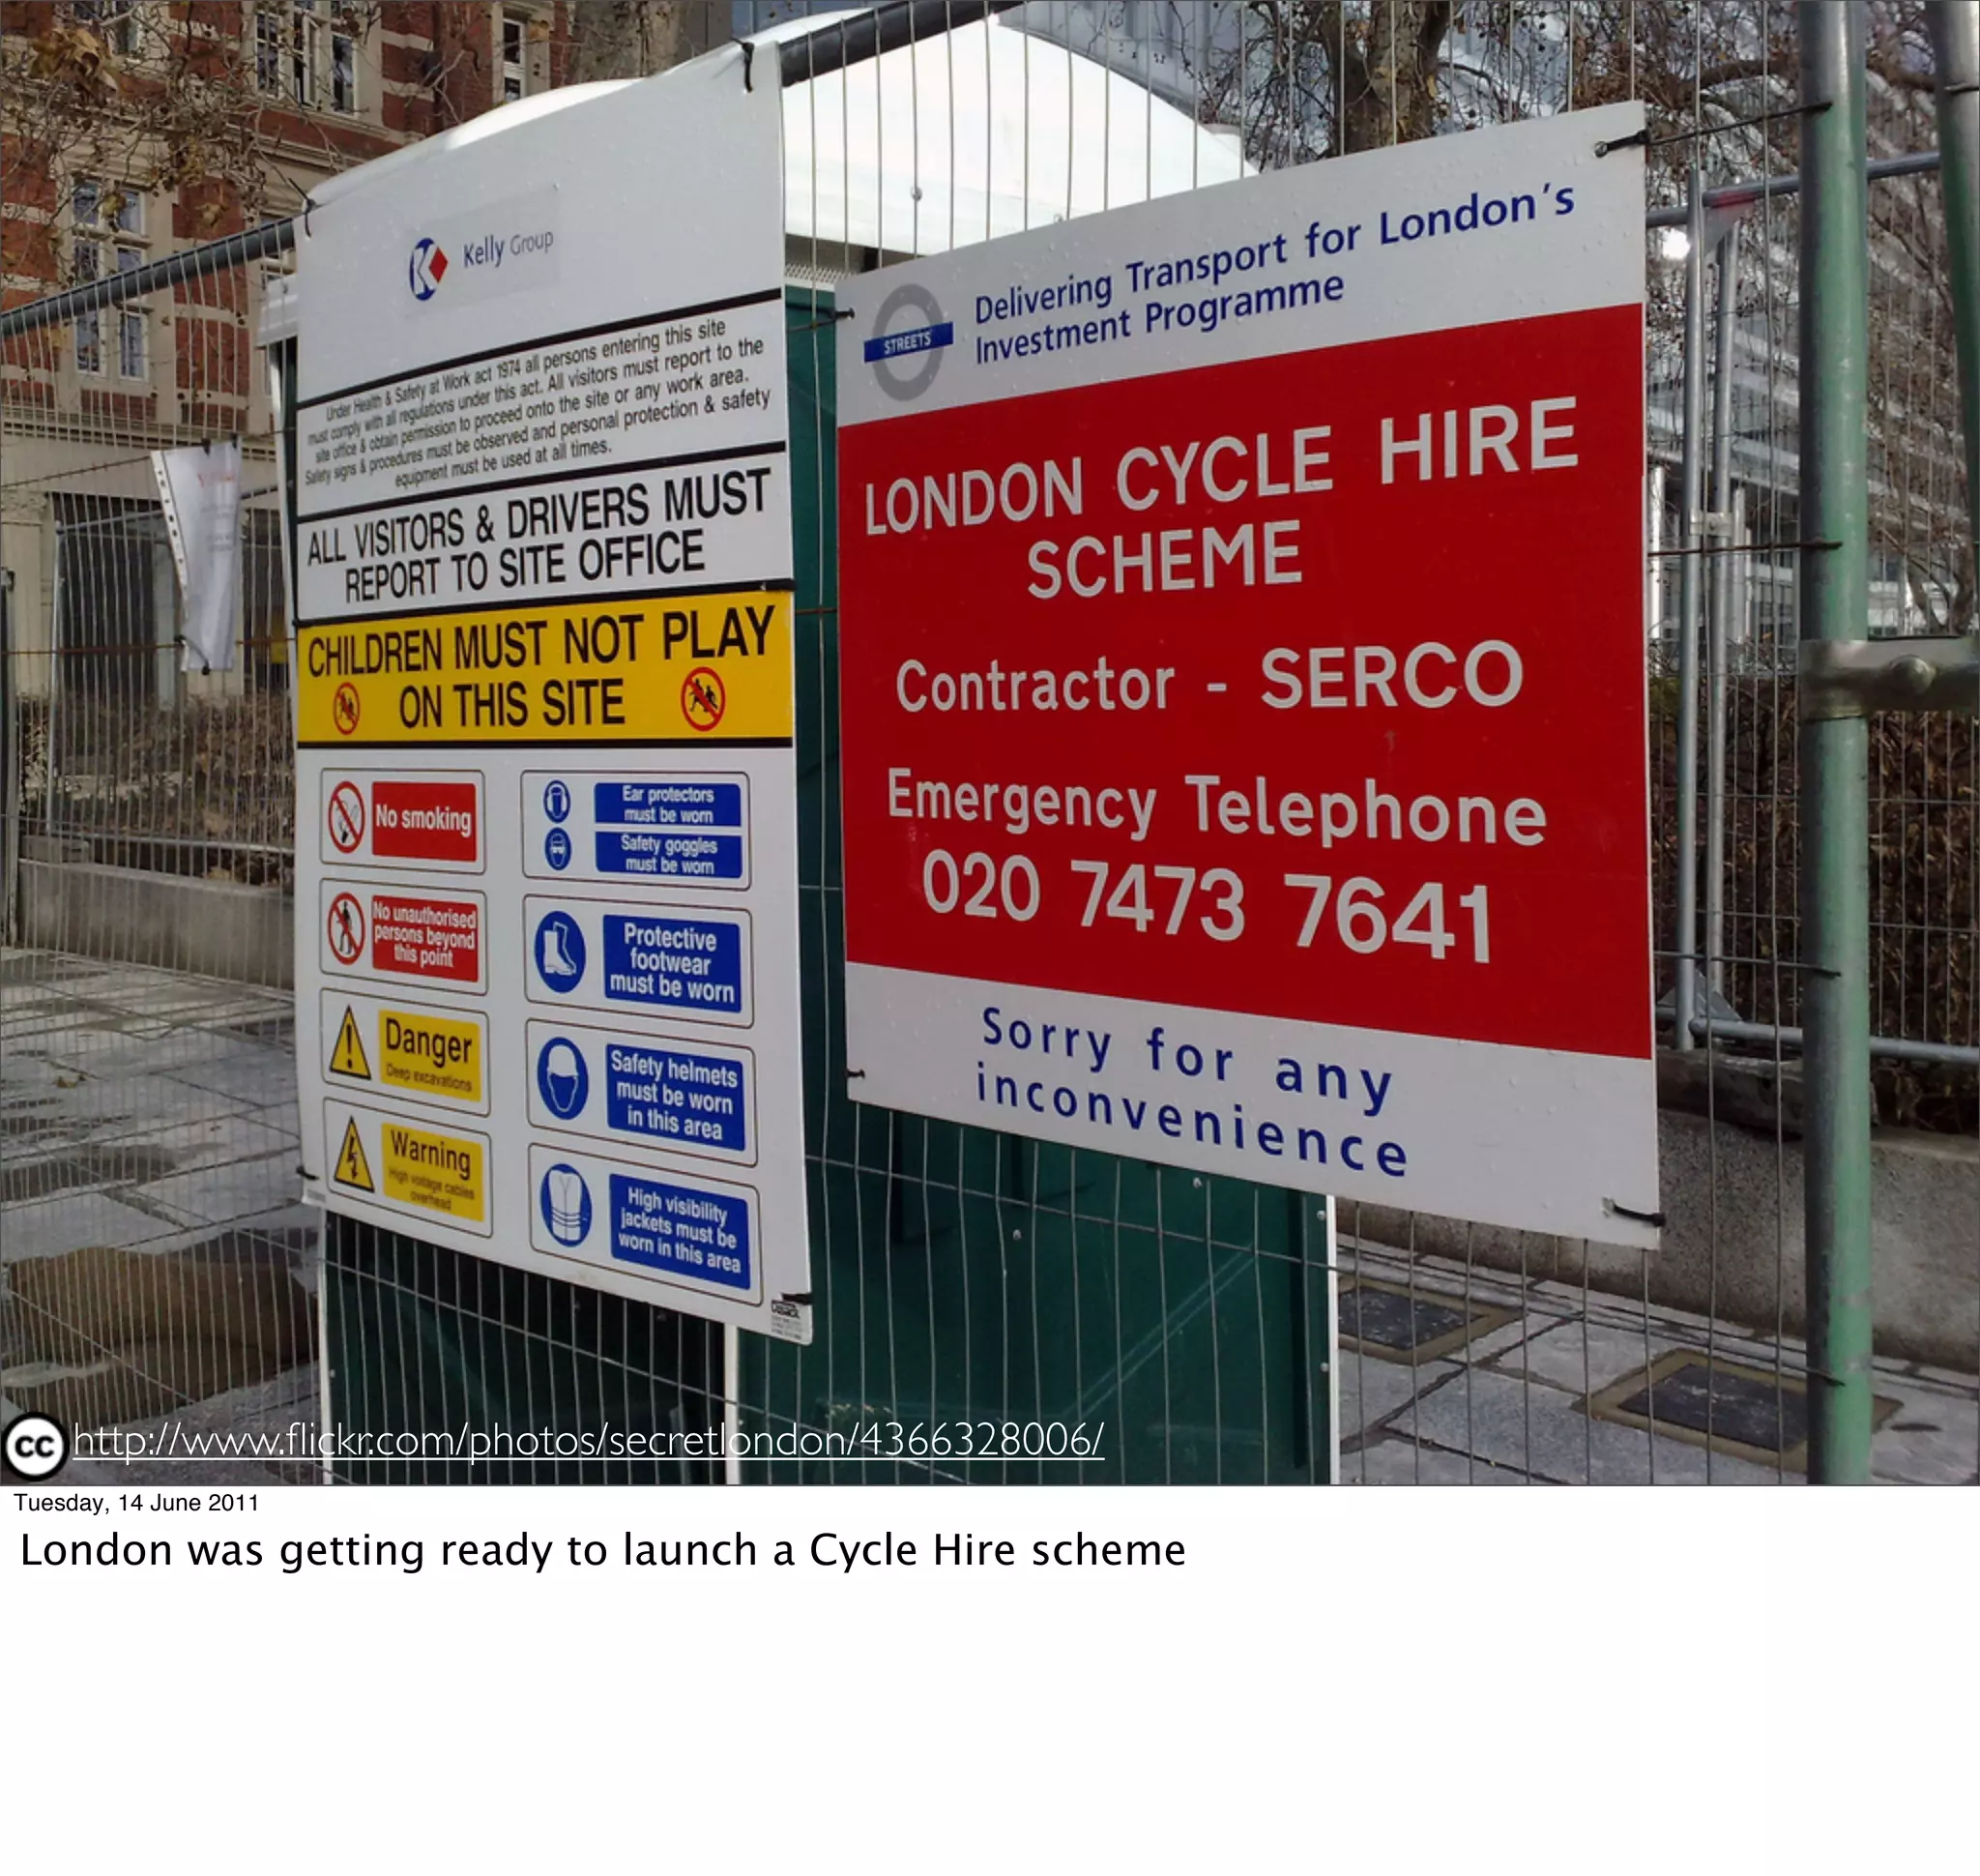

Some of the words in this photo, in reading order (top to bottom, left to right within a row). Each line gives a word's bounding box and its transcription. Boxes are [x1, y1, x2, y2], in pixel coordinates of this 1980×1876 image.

[463, 234, 506, 268] Kelly
[510, 231, 554, 256] Group
[975, 269, 1113, 326] Delivering
[1127, 233, 1288, 295] Transport
[1305, 220, 1362, 259] for
[1381, 182, 1576, 245] London's
[884, 328, 932, 355] STREETS
[975, 310, 1132, 365] Investment
[1145, 274, 1345, 335] Programme
[443, 371, 470, 391] Work
[475, 367, 491, 383] act
[497, 359, 521, 378] 1974
[526, 353, 539, 372] all
[543, 345, 597, 373] persons
[602, 333, 659, 358] entering
[665, 324, 692, 345] this
[698, 319, 725, 339] site
[399, 398, 454, 426] regulations
[458, 391, 490, 410] under
[494, 384, 516, 402] this
[521, 379, 543, 396] act.
[548, 372, 564, 391] All
[568, 366, 618, 388] visitors
[623, 356, 658, 378] must
[665, 346, 711, 372] report
[717, 343, 732, 361] to
[739, 337, 764, 357] the
[401, 419, 456, 448] permission
[460, 417, 471, 431] to
[475, 404, 522, 433] proceed
[526, 401, 555, 419] onto
[559, 395, 580, 413] the
[585, 389, 610, 409] site
[614, 388, 629, 403] or
[635, 382, 660, 402] any
[667, 371, 703, 395] work
[710, 368, 749, 388] area.
[369, 449, 423, 476] procedures
[426, 441, 452, 459] must
[456, 438, 470, 454] be
[474, 425, 529, 451] observed
[533, 421, 556, 442] and
[561, 409, 619, 440] personal
[624, 400, 699, 430] protection
[704, 395, 714, 414] &
[722, 388, 771, 411] safety
[394, 463, 448, 489] equipment
[451, 458, 479, 478] must
[483, 456, 497, 471] be
[502, 449, 531, 469] used
[536, 446, 547, 463] at
[552, 441, 567, 461] all
[570, 439, 612, 457] times.
[865, 456, 1083, 537] LONDON
[1117, 425, 1334, 513] CYCLE
[1381, 396, 1579, 485] HIRE
[307, 529, 346, 567] ALL
[354, 508, 464, 559] VISITORS
[477, 506, 495, 542] &
[508, 482, 650, 540] DRIVERS
[665, 468, 772, 522] MUST
[345, 557, 441, 604] REPORT
[451, 551, 488, 593] TO
[500, 542, 567, 588] SITE
[579, 528, 706, 582] OFFICE
[1028, 520, 1302, 600] SCHEME
[308, 629, 442, 679] CHILDREN
[455, 620, 547, 669] MUST
[564, 614, 645, 664] NOT
[664, 605, 776, 660] PLAY
[896, 657, 1175, 713] Contractor
[1262, 639, 1524, 710] SERCO
[399, 685, 442, 729] ON
[453, 682, 529, 728] THIS
[542, 678, 626, 727] SITE
[623, 784, 643, 802] Ear
[648, 786, 714, 806] protectors
[624, 807, 655, 823] must
[659, 807, 677, 823] be
[681, 810, 713, 824] worn
[888, 767, 1156, 842] Emergency
[1184, 775, 1548, 848] Telephone
[375, 804, 397, 829] No
[401, 806, 471, 838] smoking
[621, 834, 660, 854] Safety
[665, 836, 717, 857] goggles
[626, 857, 657, 872] must
[661, 858, 678, 873] be
[682, 861, 714, 875] worn
[373, 901, 391, 920] No
[393, 905, 476, 929] unauthorised
[922, 849, 1039, 923] 020
[1070, 859, 1245, 942] 7473
[1284, 873, 1491, 963] 7641
[374, 923, 423, 944] persons
[426, 927, 476, 951] beyond
[393, 944, 417, 963] this
[421, 949, 453, 968] point
[625, 923, 716, 952] Protective
[630, 948, 712, 976] footwear
[610, 974, 654, 995] must
[659, 976, 682, 997] be
[688, 982, 735, 1004] worn
[386, 1017, 473, 1069] Danger
[982, 1007, 1111, 1074] Sorry
[1148, 1027, 1233, 1082] for
[1276, 1055, 1392, 1118] any
[387, 1063, 411, 1080] Deep
[413, 1069, 472, 1093] excavations
[610, 1049, 664, 1082] Safety
[668, 1055, 738, 1089] helmets
[617, 1080, 658, 1104] must
[662, 1083, 684, 1106] be
[689, 1091, 733, 1115] worn
[976, 1062, 1409, 1178] inconvenience
[627, 1105, 643, 1128] in
[648, 1108, 679, 1133] this
[684, 1117, 722, 1141] area
[391, 1129, 471, 1181] Warning
[620, 1208, 672, 1235] jackets
[676, 1221, 713, 1246] must
[717, 1227, 737, 1249] be
[627, 1187, 662, 1212] High
[665, 1192, 728, 1228] visibility
[618, 1231, 654, 1253] worn
[657, 1235, 672, 1256] in
[675, 1240, 703, 1265] this
[707, 1250, 742, 1275] area
